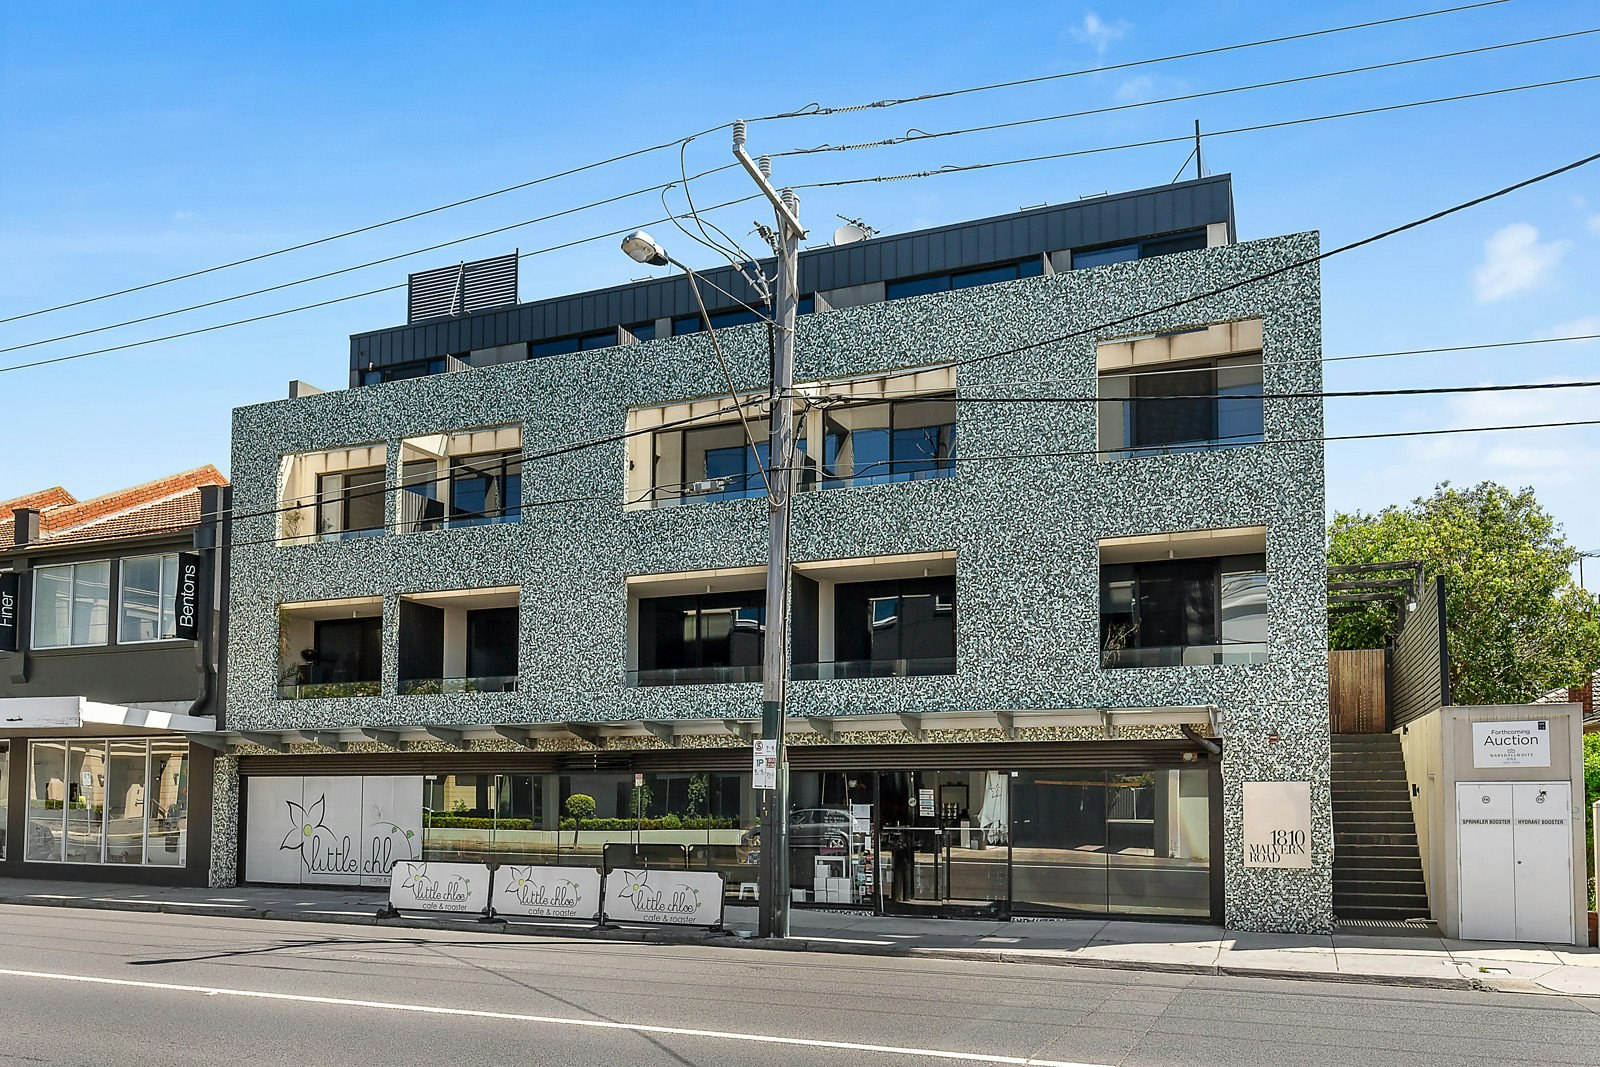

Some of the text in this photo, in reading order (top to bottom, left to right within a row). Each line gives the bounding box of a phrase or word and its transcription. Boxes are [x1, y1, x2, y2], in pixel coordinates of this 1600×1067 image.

[180, 565, 196, 627] Bentons
[0, 591, 14, 627] Finer
[1484, 734, 1539, 746] Auction
[756, 758, 764, 767] 1P
[1269, 829, 1306, 846] 1810
[311, 835, 392, 874] little chl
[1249, 844, 1306, 854] MALVERN
[1249, 852, 1281, 863] ROAD
[416, 881, 466, 901] little chloe
[521, 885, 575, 906] little chloe
[422, 902, 438, 910] cafe
[636, 890, 694, 912] little chloe
[528, 908, 577, 917] cafe & roaster
[643, 913, 696, 924] cafe & roaster
